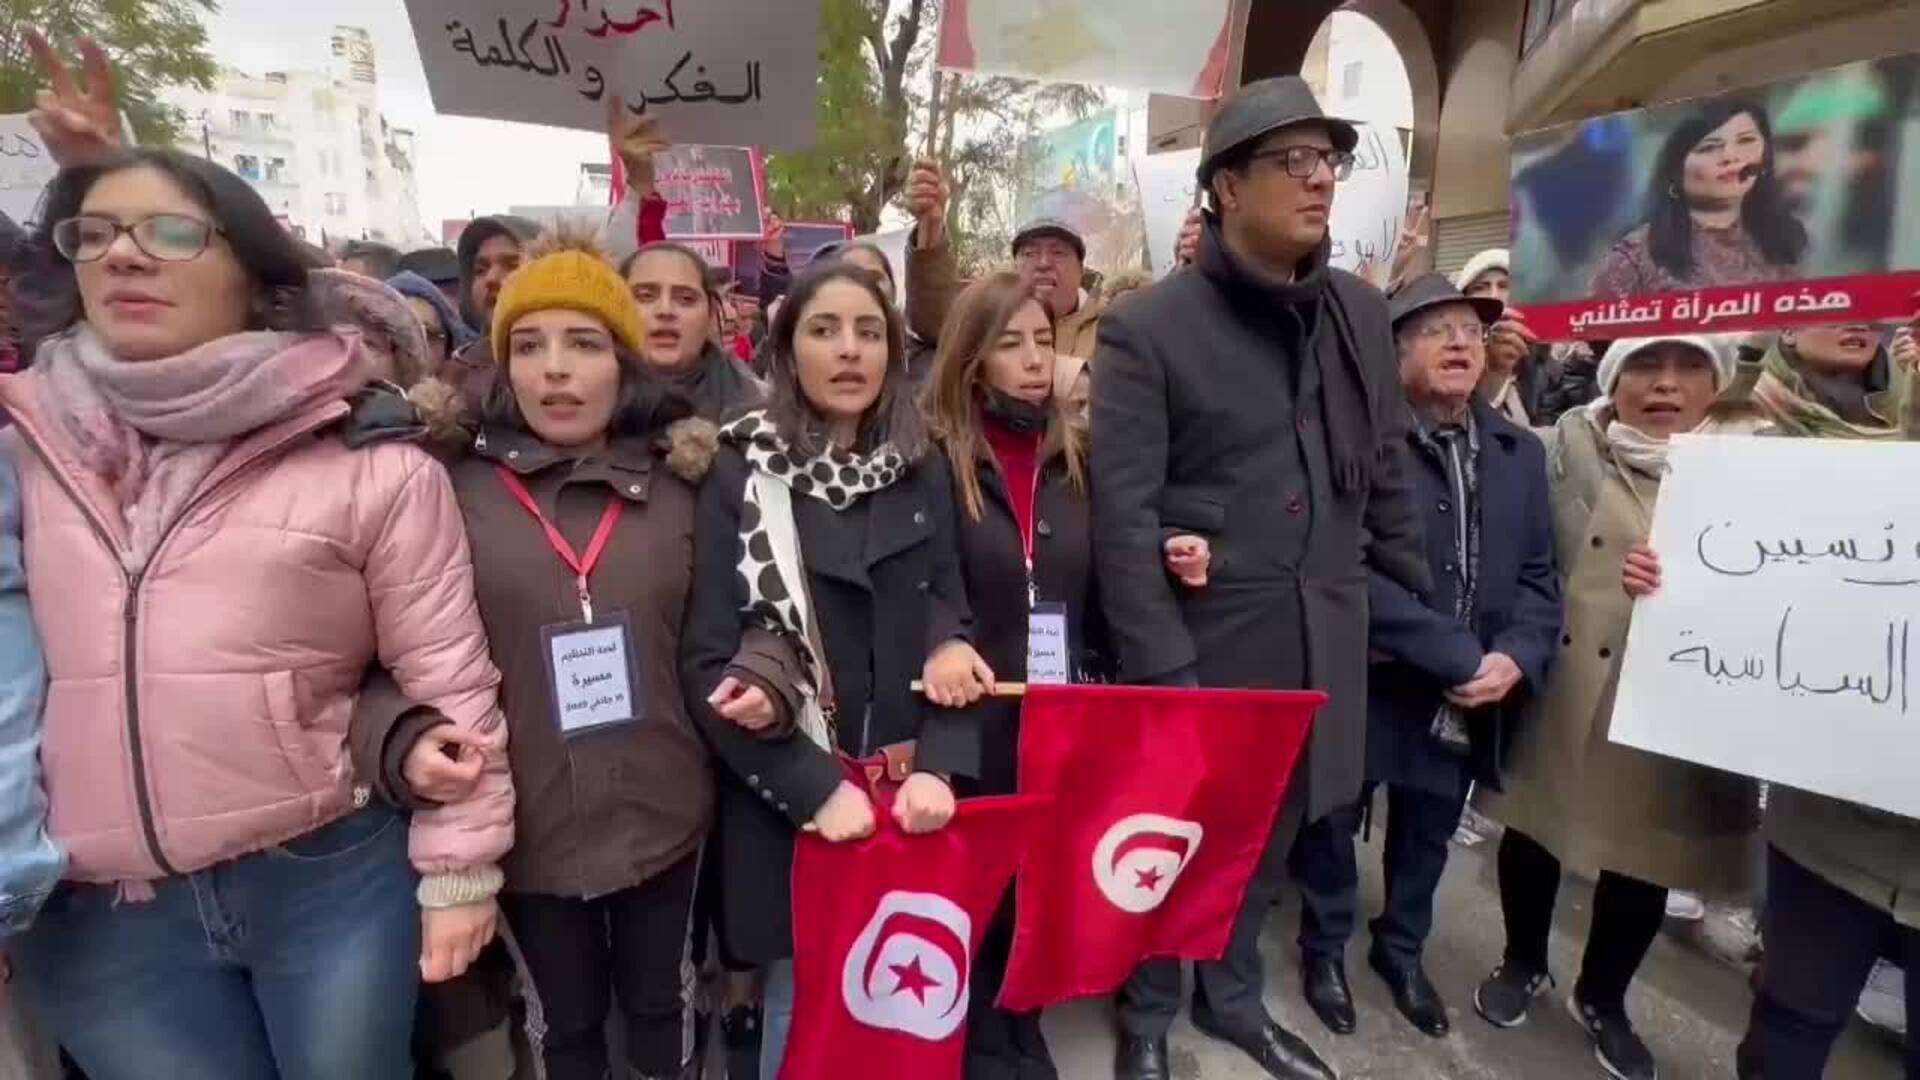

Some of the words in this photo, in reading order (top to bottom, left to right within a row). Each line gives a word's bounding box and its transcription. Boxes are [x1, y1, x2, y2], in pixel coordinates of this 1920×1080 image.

[627, 51, 761, 115] الفكر
[1671, 291, 1761, 325] المرأة
[1773, 287, 1851, 313] هذه
[1667, 605, 1909, 716] السياسية
